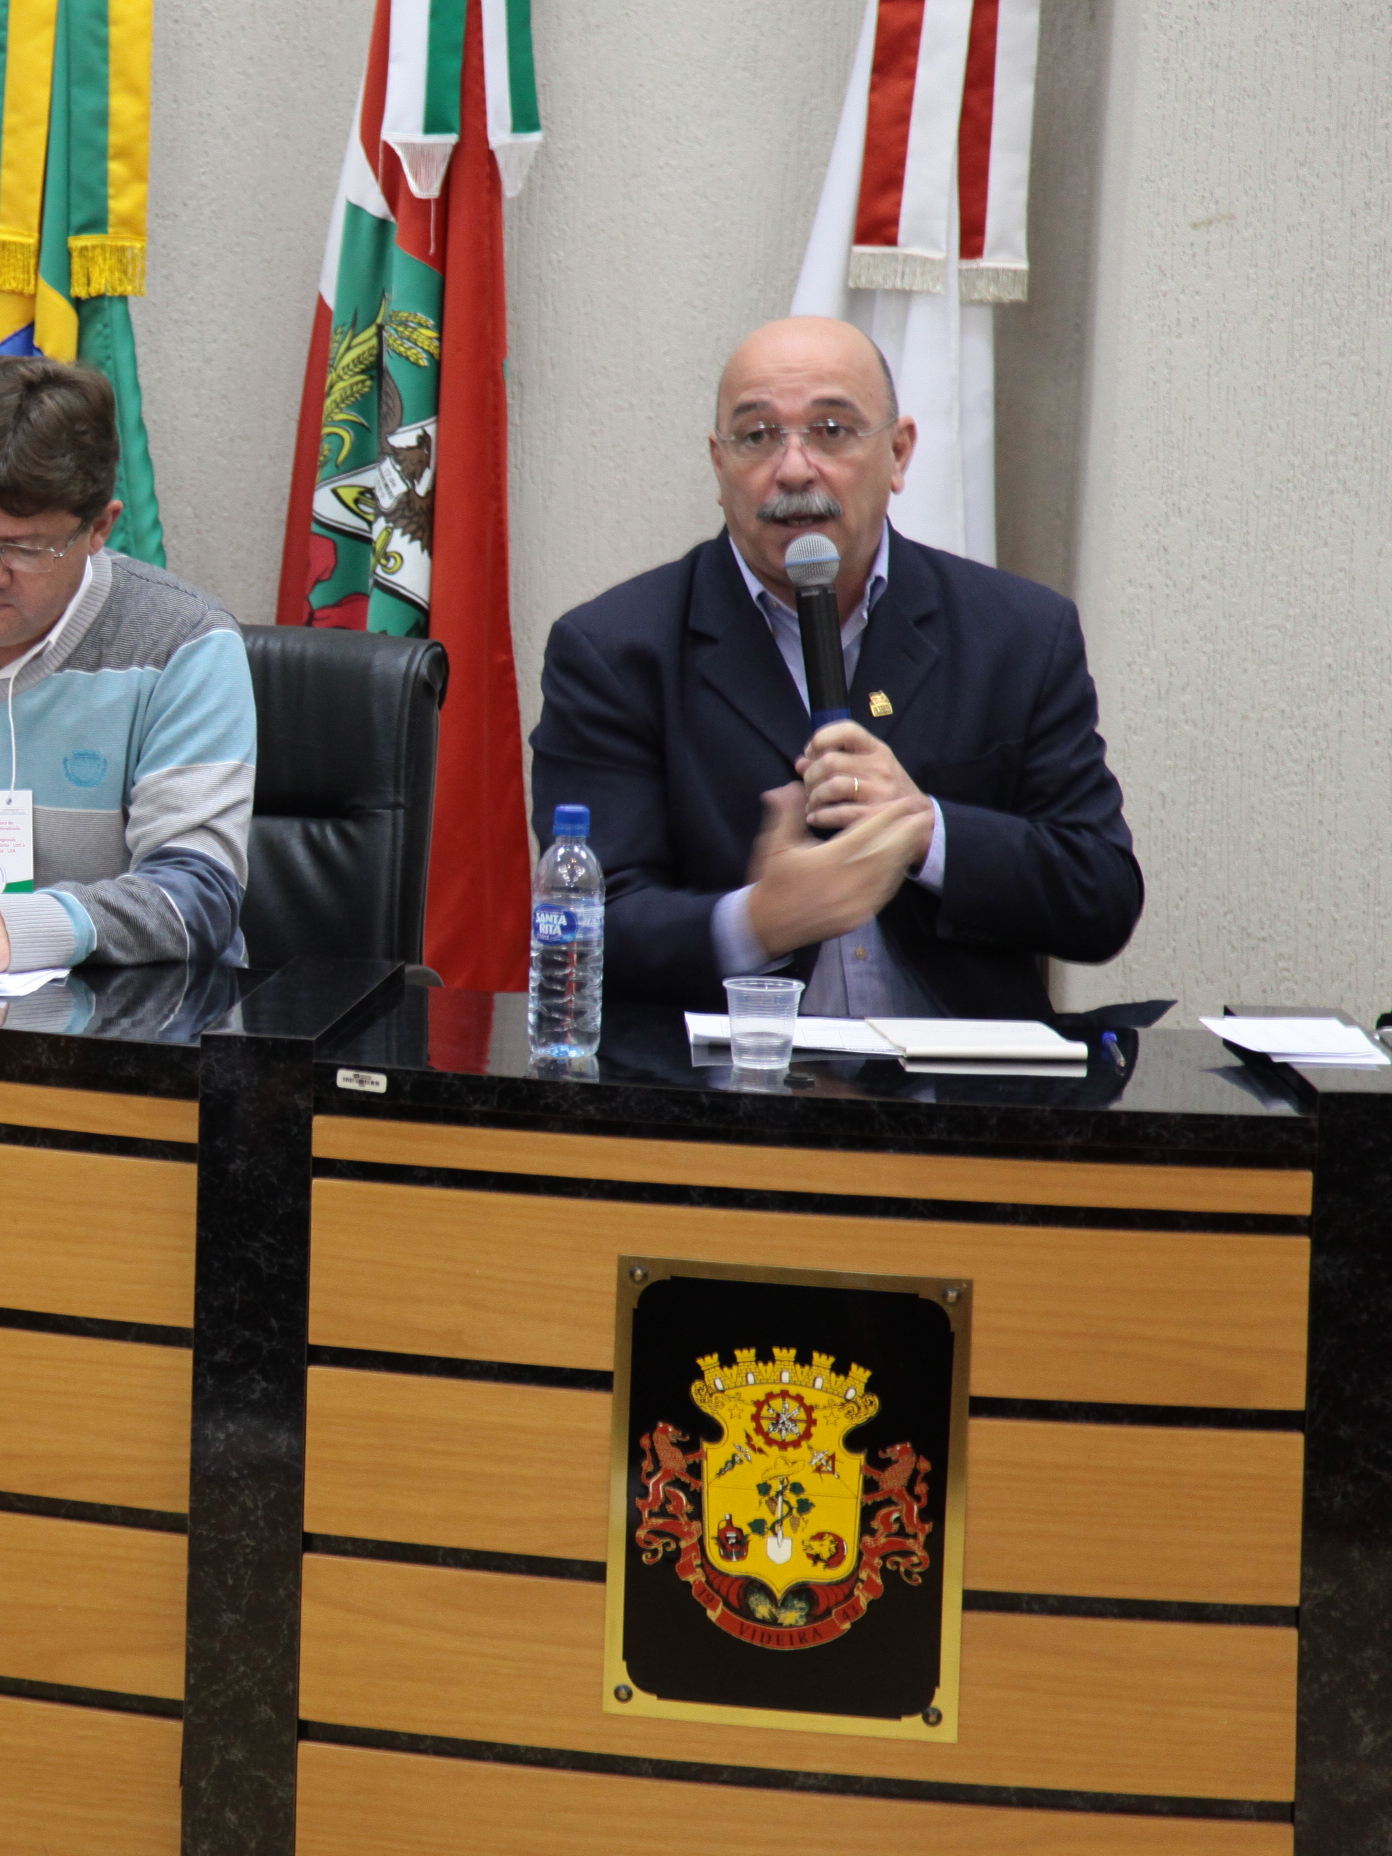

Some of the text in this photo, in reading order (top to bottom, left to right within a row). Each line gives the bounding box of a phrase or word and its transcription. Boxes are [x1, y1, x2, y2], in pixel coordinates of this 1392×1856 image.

[535, 911, 568, 926] SANTA
[539, 923, 562, 936] RITA
[738, 1622, 824, 1647] VIDEIRA
